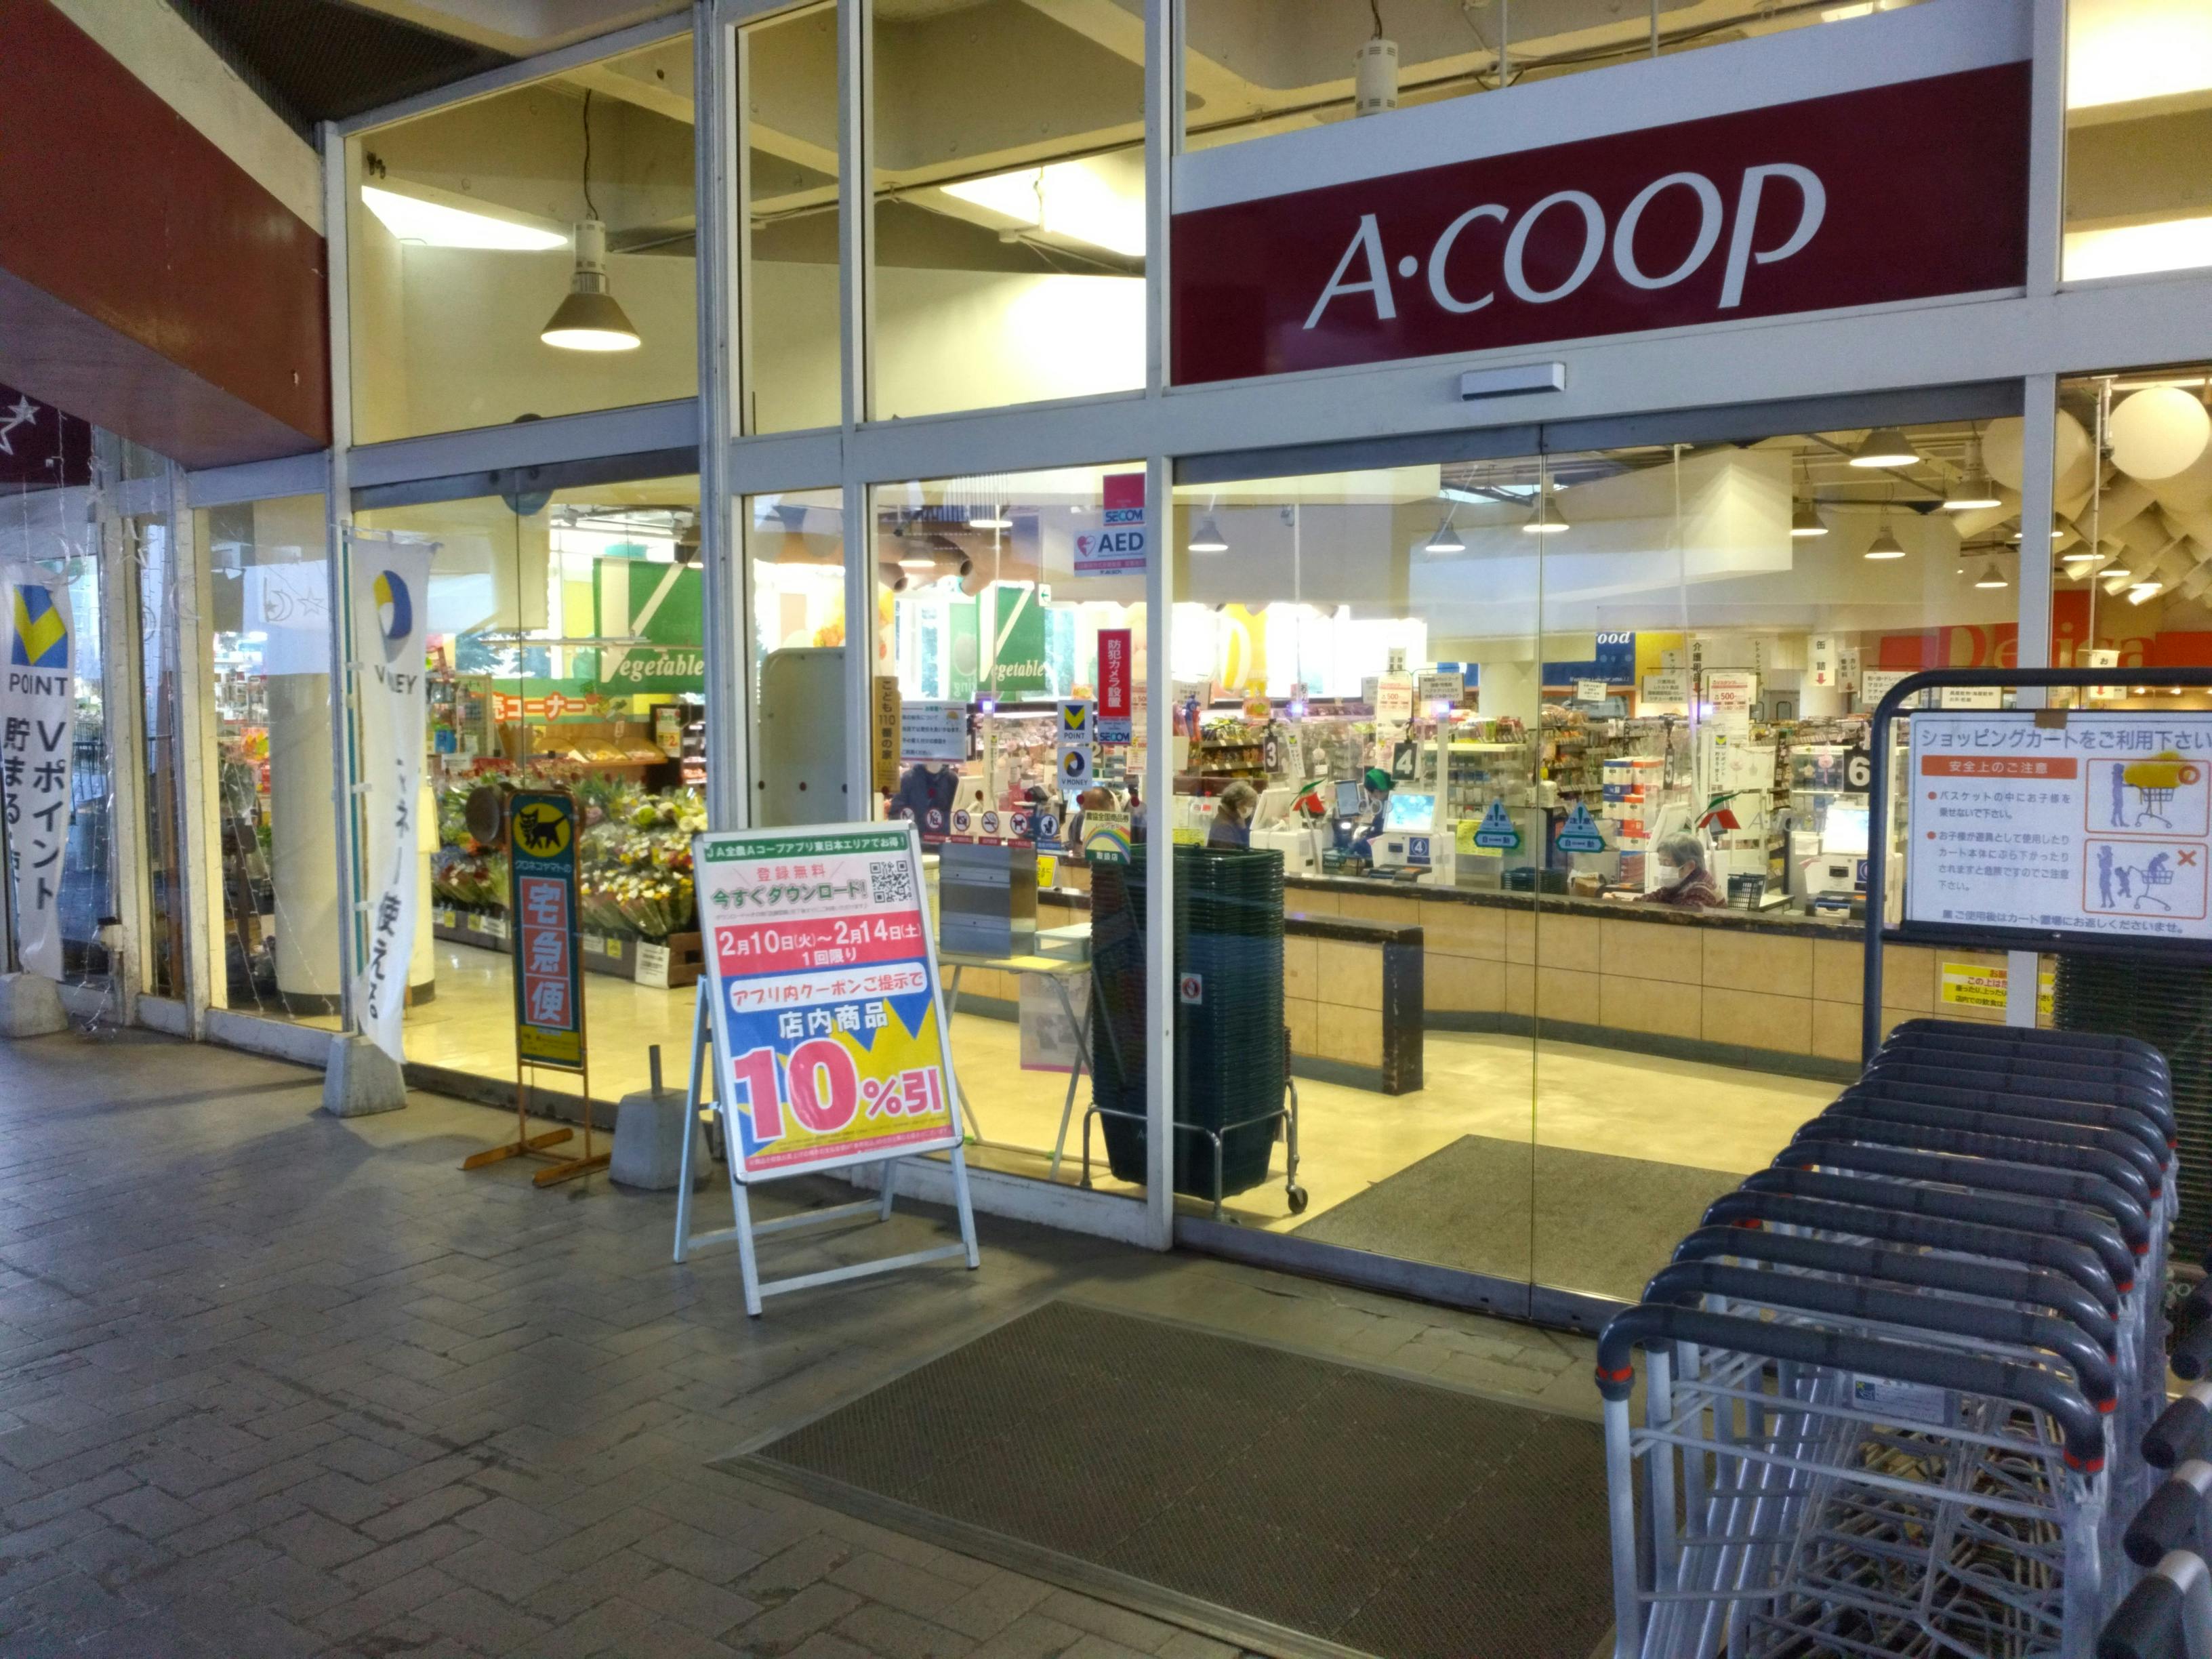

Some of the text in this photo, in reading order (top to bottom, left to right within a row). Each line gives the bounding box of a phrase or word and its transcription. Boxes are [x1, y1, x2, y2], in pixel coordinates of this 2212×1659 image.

[1105, 509, 1143, 523] SECOM
[1098, 532, 1145, 552] AED
[1595, 631, 1631, 644] ood
[1816, 640, 1826, 671] 缶詰
[1107, 639, 1122, 708] 防犯カメラ設置
[9, 673, 67, 697] POINT
[1720, 692, 1735, 700] 500
[1099, 732, 1130, 742] SECOM
[1921, 728, 2212, 752] ショッピングカートをご利用下さい
[1090, 741, 1102, 763] 2
[1267, 741, 1277, 767] 3
[1396, 749, 1413, 775] 4
[1665, 756, 1673, 783] 5
[1848, 756, 1870, 786] 6
[1948, 760, 2049, 775] 安全上のご注意
[1939, 790, 2071, 804] バスケットの中にお子様を
[32, 720, 67, 910] Vポイント
[1939, 807, 2013, 820] 乗せないで下さい。
[1938, 830, 2070, 846] お子様が遊具として使用したり
[1938, 848, 2070, 863] カート本体にぶら下がったり
[515, 860, 571, 874] クロネコヤマトの
[756, 863, 826, 882] 登録無料
[1938, 880, 1971, 891] 下さい。
[527, 882, 566, 1022] 宅急便
[802, 948, 857, 967] 1回限り
[733, 970, 924, 1007] アプリ内クーポンご提示で
[779, 1001, 890, 1040] 店内商品
